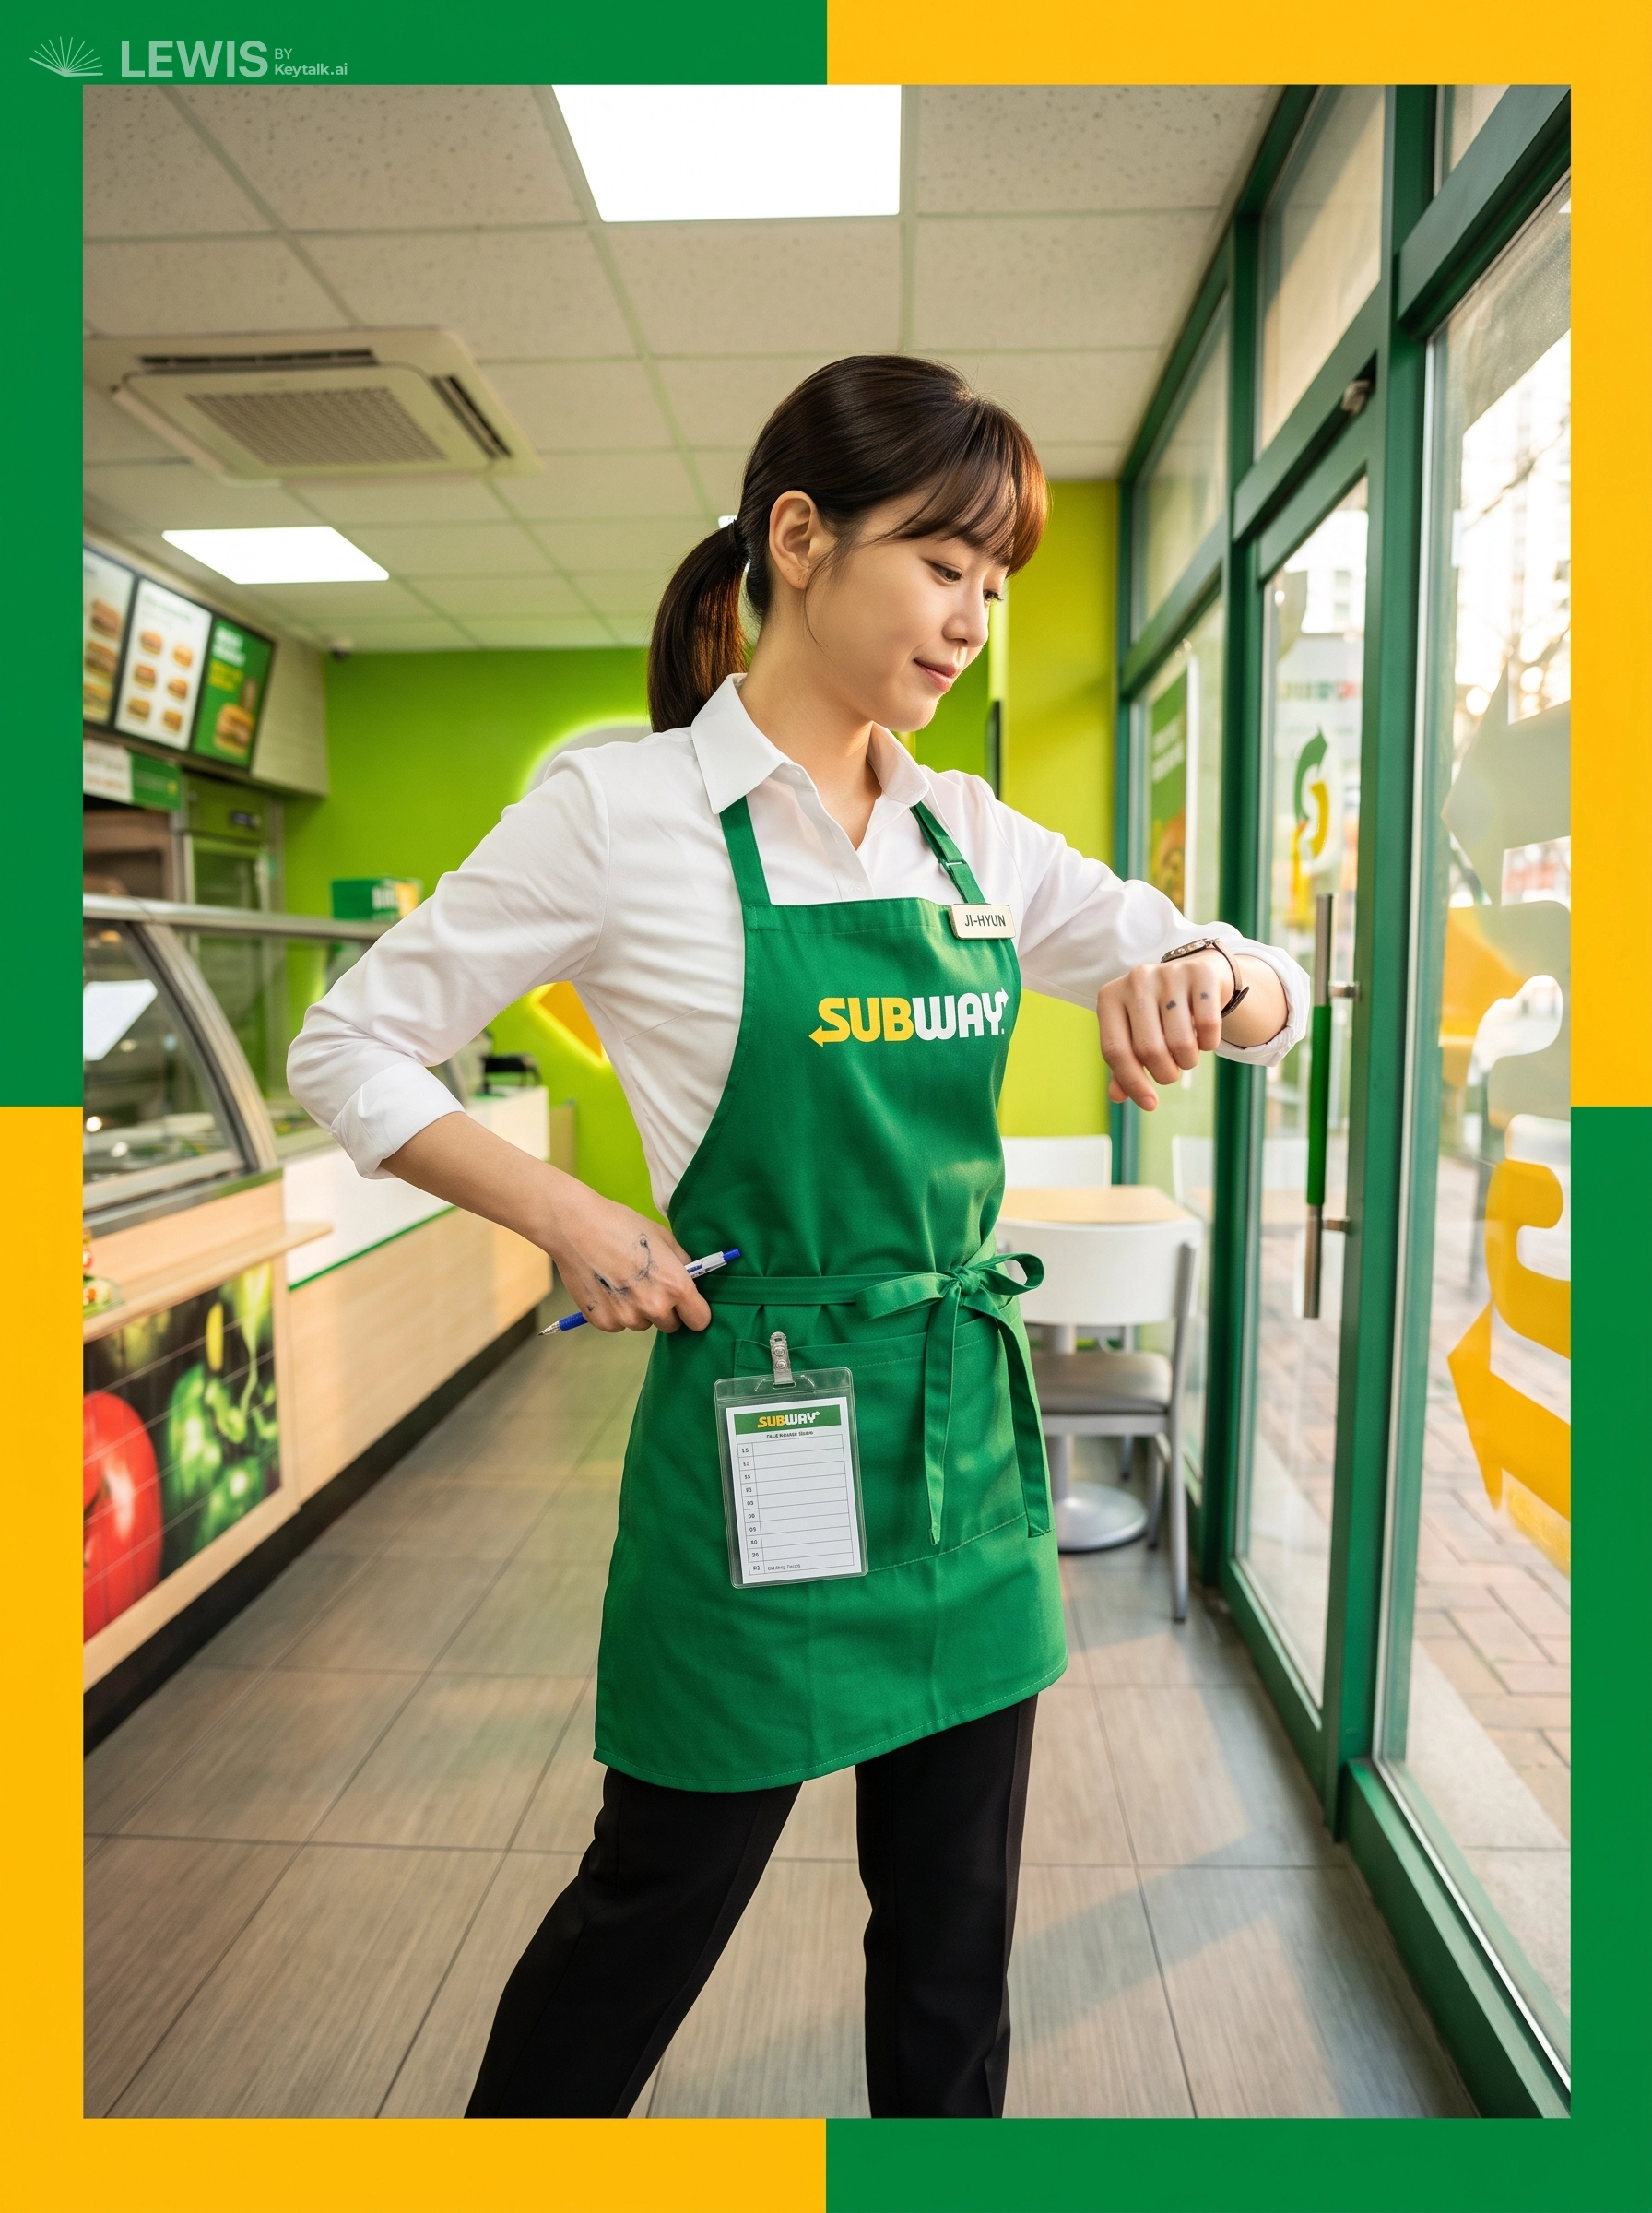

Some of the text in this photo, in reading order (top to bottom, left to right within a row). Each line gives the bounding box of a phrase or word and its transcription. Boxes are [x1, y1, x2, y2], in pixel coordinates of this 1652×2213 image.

[964, 914, 1007, 928] JI-HYUN
[808, 987, 1009, 1048] SUBWAY
[757, 1411, 820, 1428] SUBWAY
